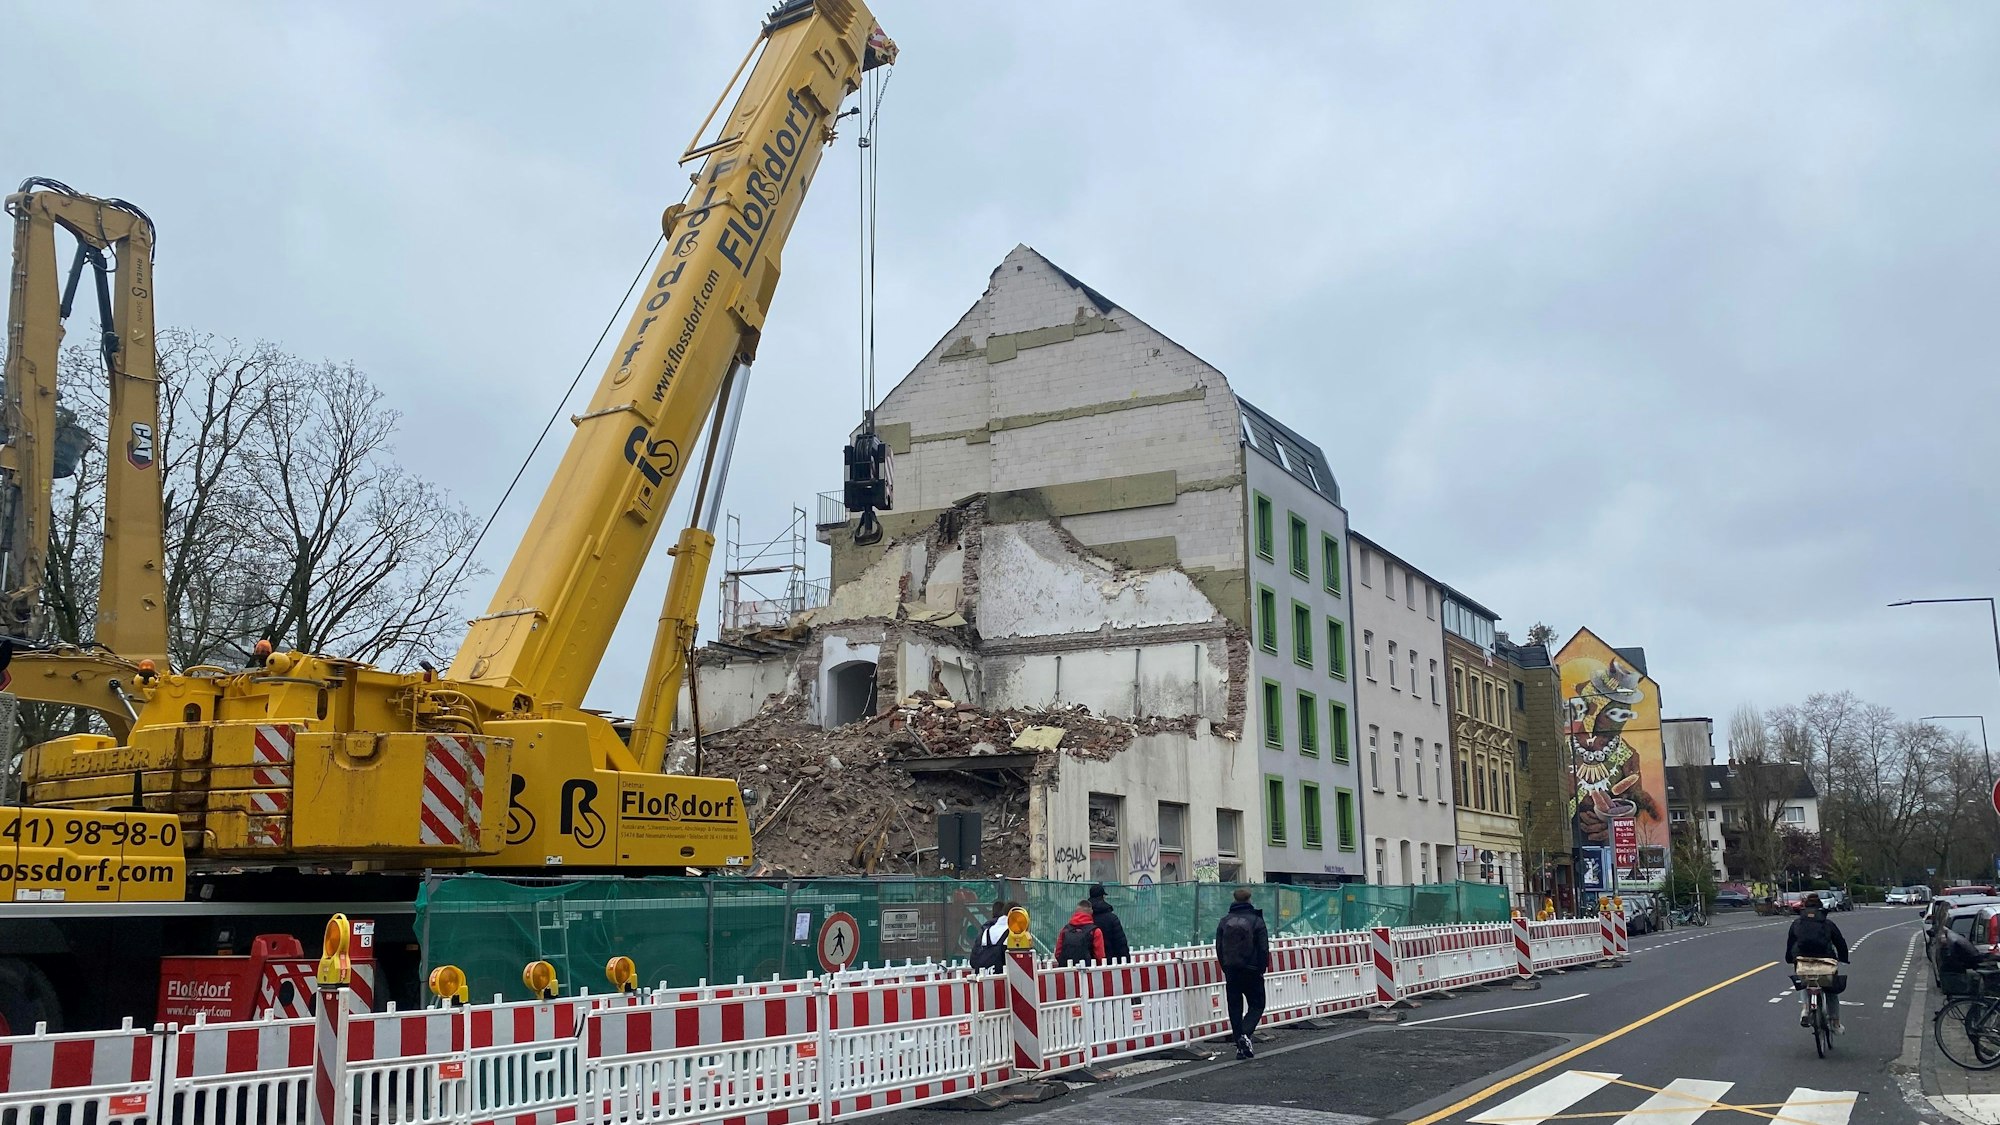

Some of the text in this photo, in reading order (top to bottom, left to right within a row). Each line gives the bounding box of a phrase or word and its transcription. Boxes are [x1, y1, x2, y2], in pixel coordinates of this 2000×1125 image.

[717, 87, 810, 271] Floßdorf
[652, 269, 720, 403] www.flossdorf.com
[131, 422, 153, 461] CAT
[622, 781, 645, 789] Dietmar
[621, 790, 735, 821] Floßdorf
[2, 817, 54, 847] 41)
[65, 820, 101, 845] 98
[364, 936, 370, 946] 3
